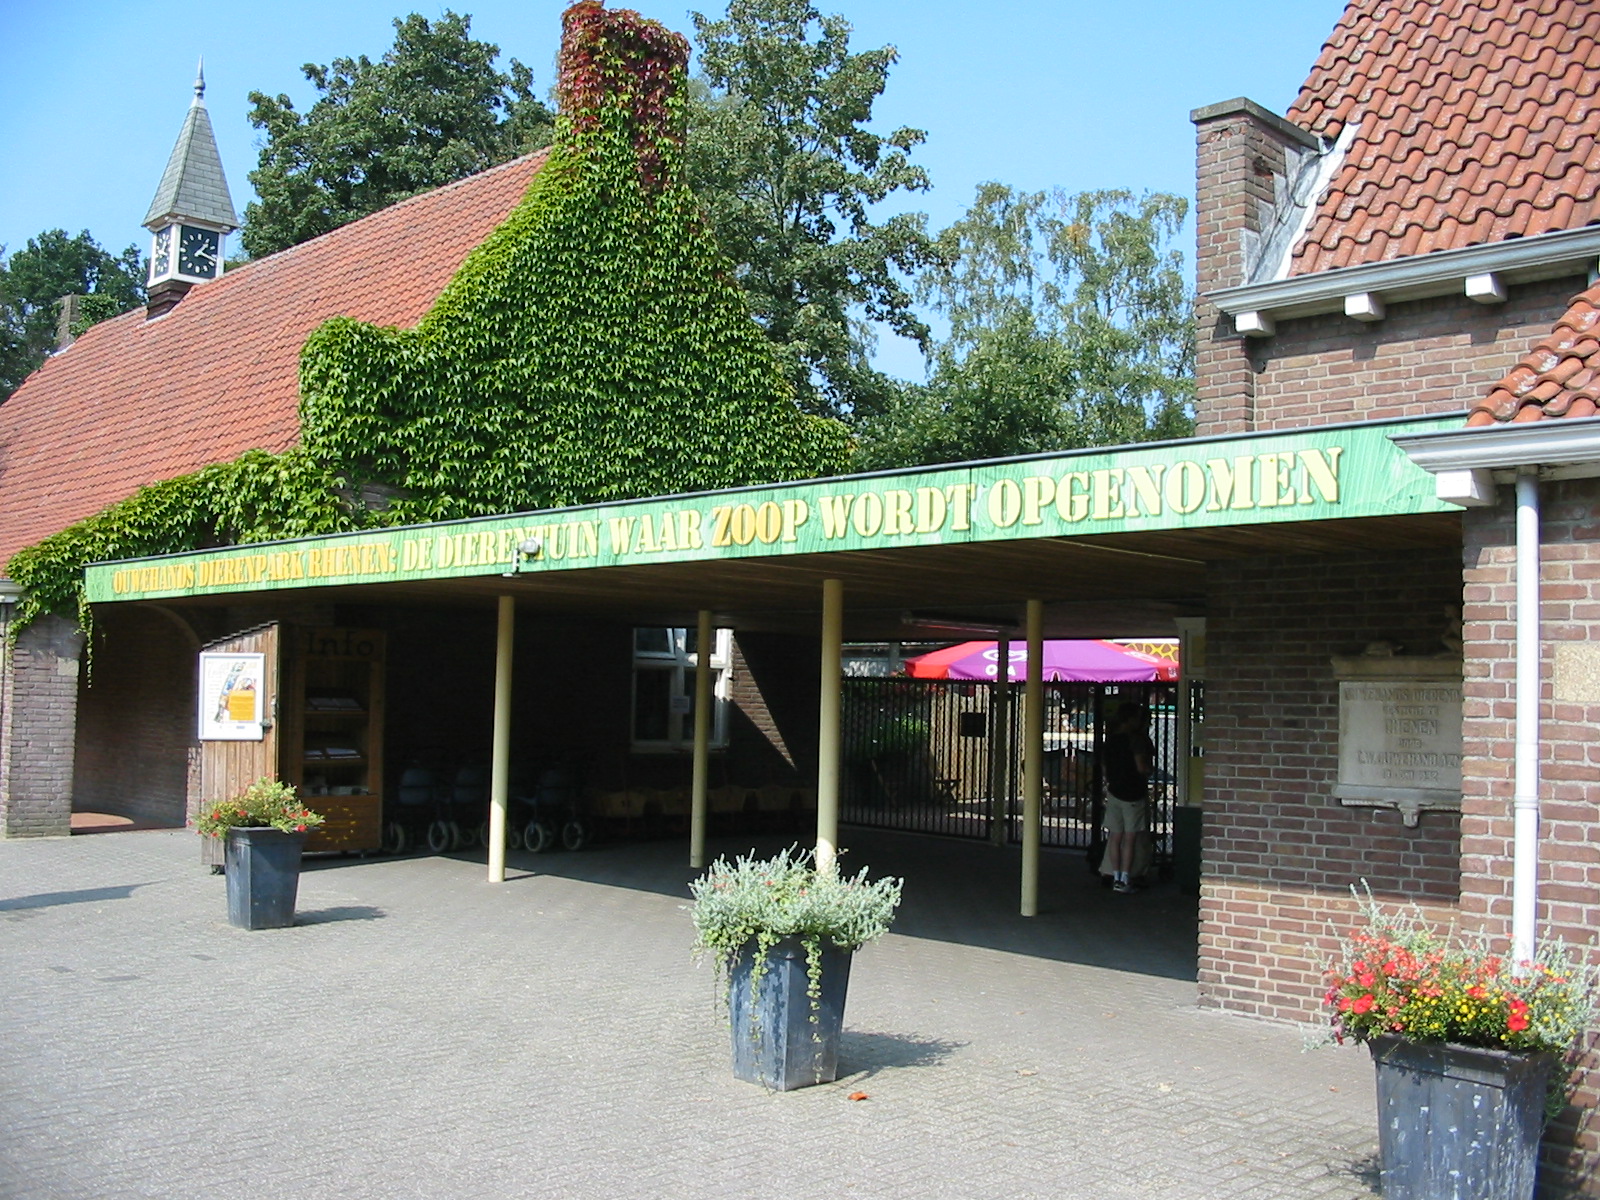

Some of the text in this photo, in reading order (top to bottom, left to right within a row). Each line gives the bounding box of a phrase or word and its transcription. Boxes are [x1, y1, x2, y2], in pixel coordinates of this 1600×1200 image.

[113, 445, 1346, 594] OUWEHANDS DIERENPARK RHENEN: DE DIERENTUIN WAAR ZOOP WORDT OPGENOMEN
